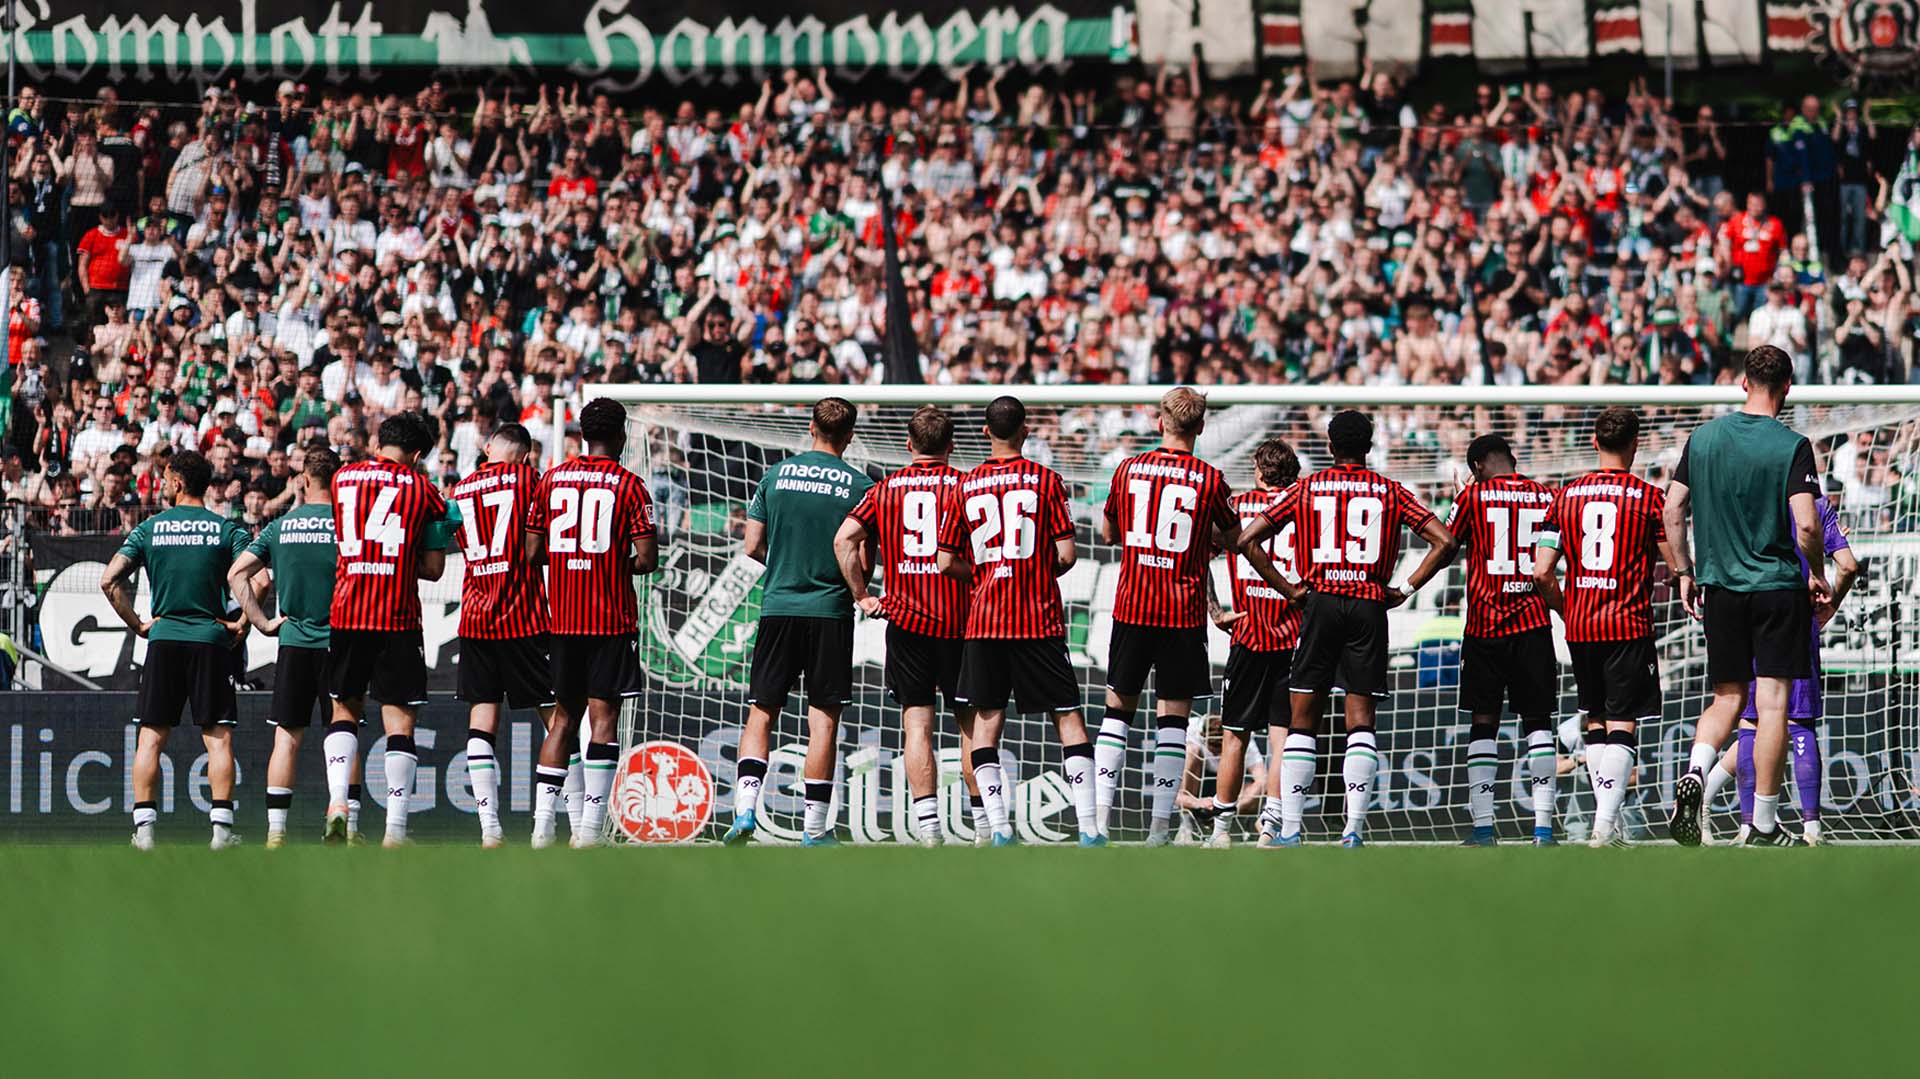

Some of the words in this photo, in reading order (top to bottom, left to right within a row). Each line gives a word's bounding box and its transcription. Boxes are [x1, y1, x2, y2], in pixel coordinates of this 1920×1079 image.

[337, 470, 392, 482] HANNOVER
[397, 474, 413, 484] 96
[552, 471, 602, 483] HANNOVER
[604, 474, 620, 485] 96
[779, 464, 853, 486] macron
[1128, 463, 1186, 479] HANNOVER
[1188, 471, 1204, 483] 96
[454, 475, 498, 496] HANNOVER
[501, 473, 517, 484] 96
[888, 475, 940, 488] HANNOVER
[943, 476, 958, 486] 96
[963, 474, 1020, 493] HANNOVER
[1023, 474, 1039, 485] 96
[1310, 481, 1368, 492] HANNOVER
[1372, 483, 1387, 494] 96
[776, 479, 832, 495] HANNOVER
[835, 486, 850, 499] 96
[1566, 484, 1623, 498] HANNOVER
[1626, 487, 1642, 499] 96
[1480, 490, 1537, 503] HANNOVER
[1539, 492, 1553, 503] 96
[338, 486, 405, 557] 14
[549, 487, 616, 553] 20
[1126, 479, 1197, 553] 16
[153, 520, 221, 534] macron
[455, 489, 515, 561] 17
[903, 491, 938, 556] 9
[966, 489, 1038, 565] 26
[1312, 496, 1383, 564] 19
[152, 535, 204, 546] HANNOVER
[206, 535, 220, 546] 96
[280, 533, 332, 544] HANNOVER
[1486, 507, 1549, 575] 15
[1582, 501, 1618, 571] 8
[473, 561, 509, 576] ALLGEIER
[898, 560, 940, 574] KÄLLMA
[1138, 554, 1174, 569] NIELSEN
[1325, 569, 1367, 582] KOKOLO
[1576, 576, 1617, 590] LEOPOLD
[328, 755, 348, 767] 96
[366, 722, 568, 813] Gel
[1098, 767, 1117, 779] 96
[743, 780, 761, 789] 96
[1156, 778, 1175, 789] 96
[1348, 782, 1368, 793] 96
[1532, 776, 1550, 786] 96
[585, 794, 603, 804] 96
